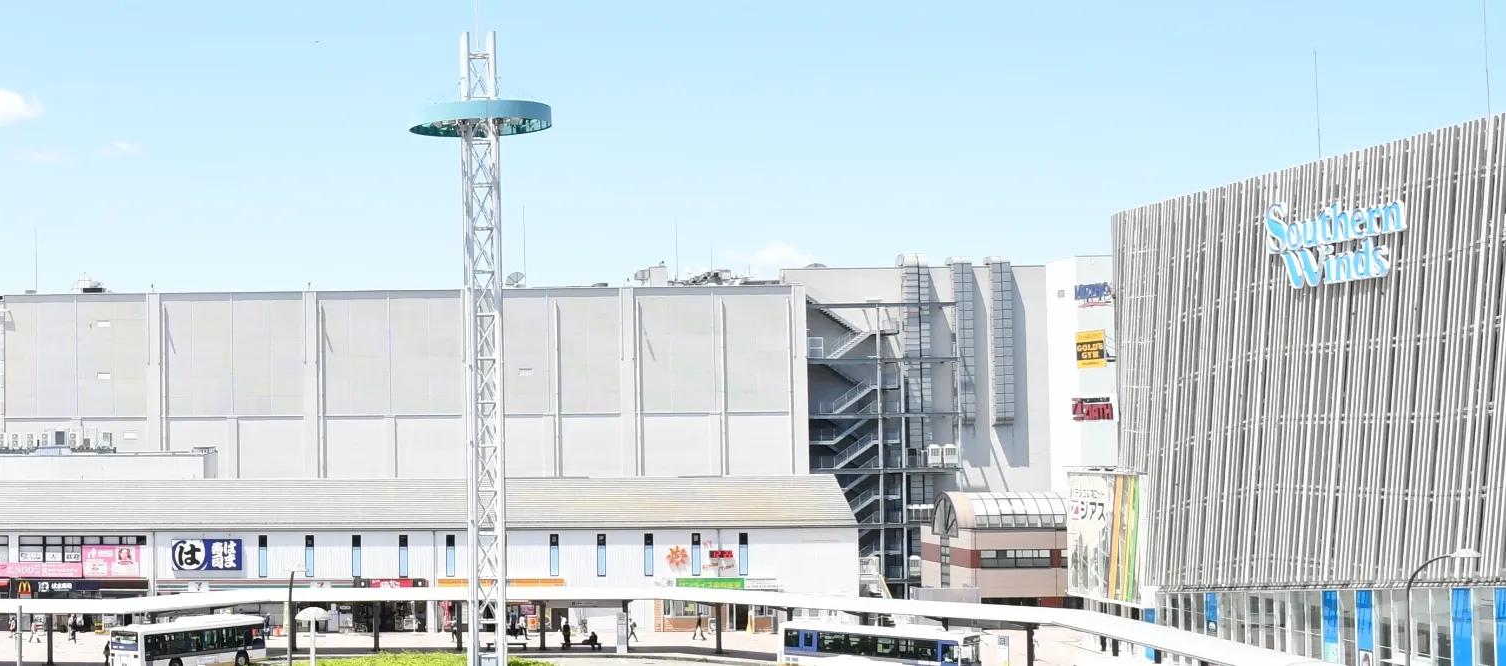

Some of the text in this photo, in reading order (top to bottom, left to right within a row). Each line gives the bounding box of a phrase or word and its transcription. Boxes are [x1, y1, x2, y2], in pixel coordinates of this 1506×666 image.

[1266, 201, 1407, 254] Southern
[1281, 238, 1390, 289] Winds
[1077, 342, 1103, 352] GOLD'S
[1081, 350, 1099, 359] GYM
[1081, 501, 1106, 521] ジアス
[178, 544, 201, 566] は
[223, 541, 237, 568] はま
